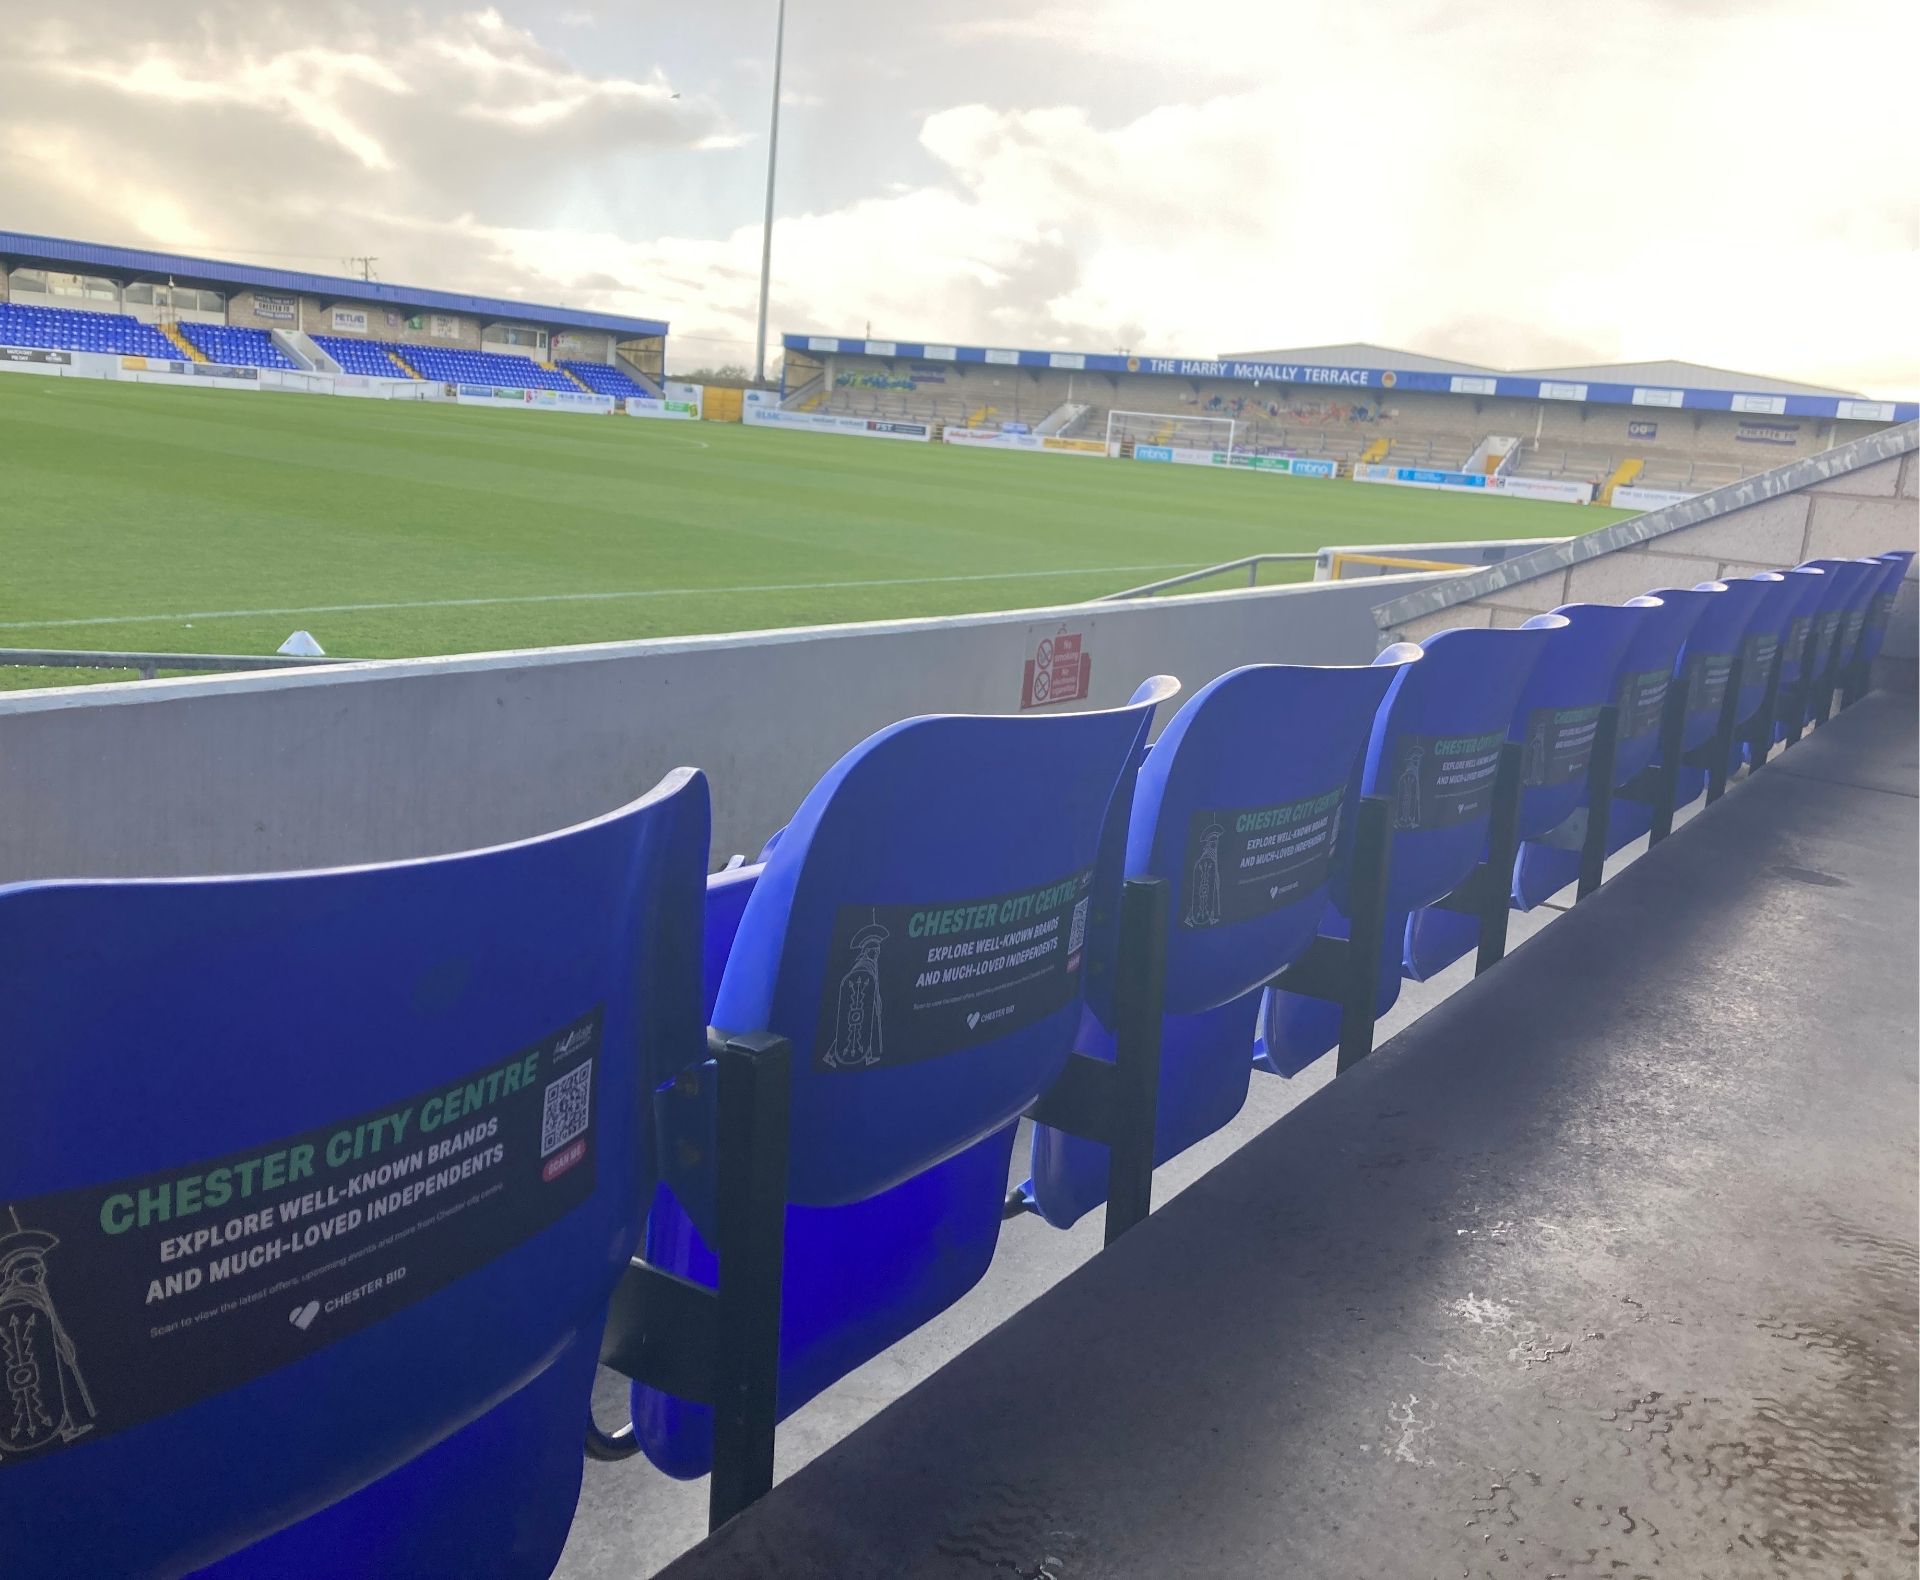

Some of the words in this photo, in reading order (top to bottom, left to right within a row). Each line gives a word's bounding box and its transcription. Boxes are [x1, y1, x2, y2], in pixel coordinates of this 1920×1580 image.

[1151, 359, 1175, 373] THE
[1181, 361, 1228, 377] HARRY
[1234, 363, 1297, 381] McNALLY
[1304, 368, 1368, 385] TERRACE
[876, 423, 893, 432] FST
[1055, 651, 1079, 663] smoking
[1236, 806, 1292, 833] CHESTER
[1247, 835, 1277, 850] EXPLORE
[1240, 854, 1255, 869] AND
[908, 903, 999, 938] CHESTER
[1000, 894, 1036, 924] CITY
[1036, 878, 1078, 914] CENTRE
[927, 939, 974, 963] EXPLORE
[976, 926, 1034, 955] WELL-KNOWN
[1034, 916, 1060, 938] BRANDS
[915, 970, 940, 988] AND
[941, 956, 1005, 981] MUCH-LOVED
[1006, 937, 1059, 967] INDEPENDENTS
[981, 1008, 1004, 1023] CHESTER
[100, 1143, 315, 1235] CHESTER
[326, 1107, 413, 1168] CITY
[419, 1051, 540, 1133] CENTRE
[548, 1154, 569, 1176] SCAN
[160, 1207, 274, 1263] EXPLORE
[279, 1150, 423, 1223] WELL-KNOWN
[427, 1116, 499, 1164] BRANDS
[145, 1268, 202, 1305] AND
[209, 1208, 363, 1283] MUCH-LOVED
[367, 1143, 504, 1222] INDEPENDENTS
[324, 1278, 383, 1313] CHESTER
[386, 1267, 407, 1285] BID
[150, 1322, 178, 1338] Scan
[181, 1317, 192, 1328] to
[194, 1307, 218, 1322] view
[221, 1301, 238, 1313] the
[240, 1288, 267, 1306] latest
